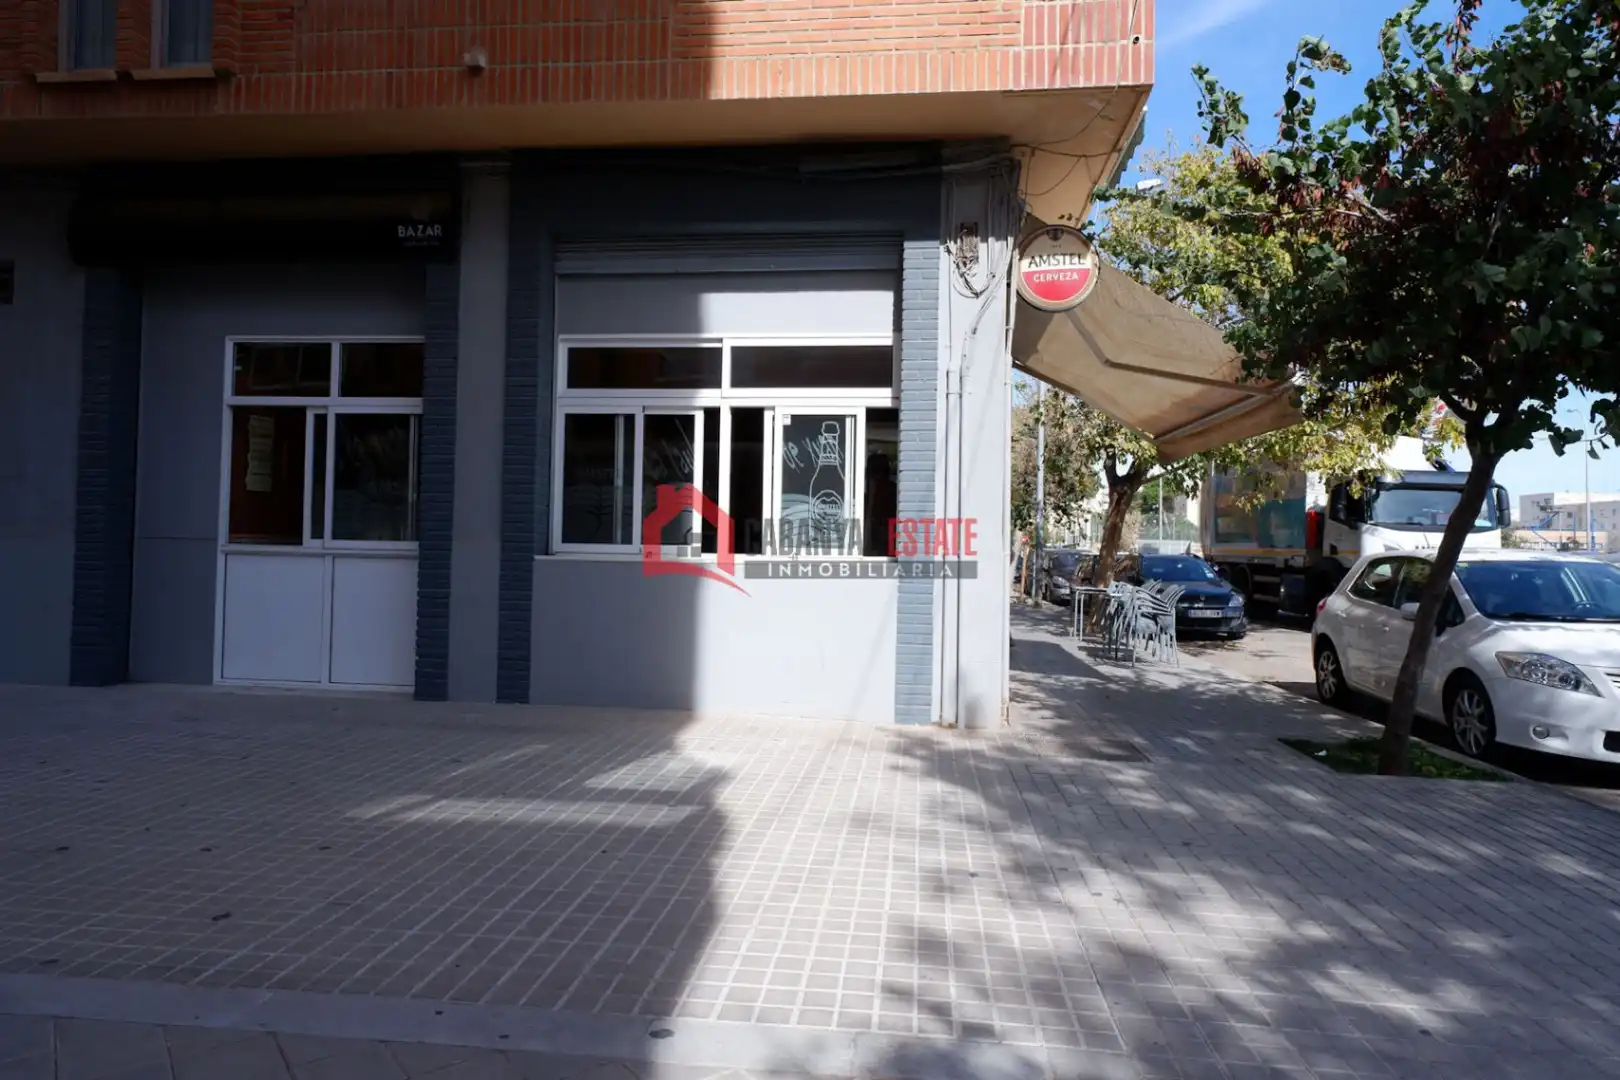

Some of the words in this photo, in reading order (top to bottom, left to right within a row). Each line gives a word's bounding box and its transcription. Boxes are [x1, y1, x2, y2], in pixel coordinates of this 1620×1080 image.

[397, 224, 442, 237] BAZAR
[1028, 252, 1086, 268] AMSTEL
[1033, 271, 1079, 283] CERVEZA
